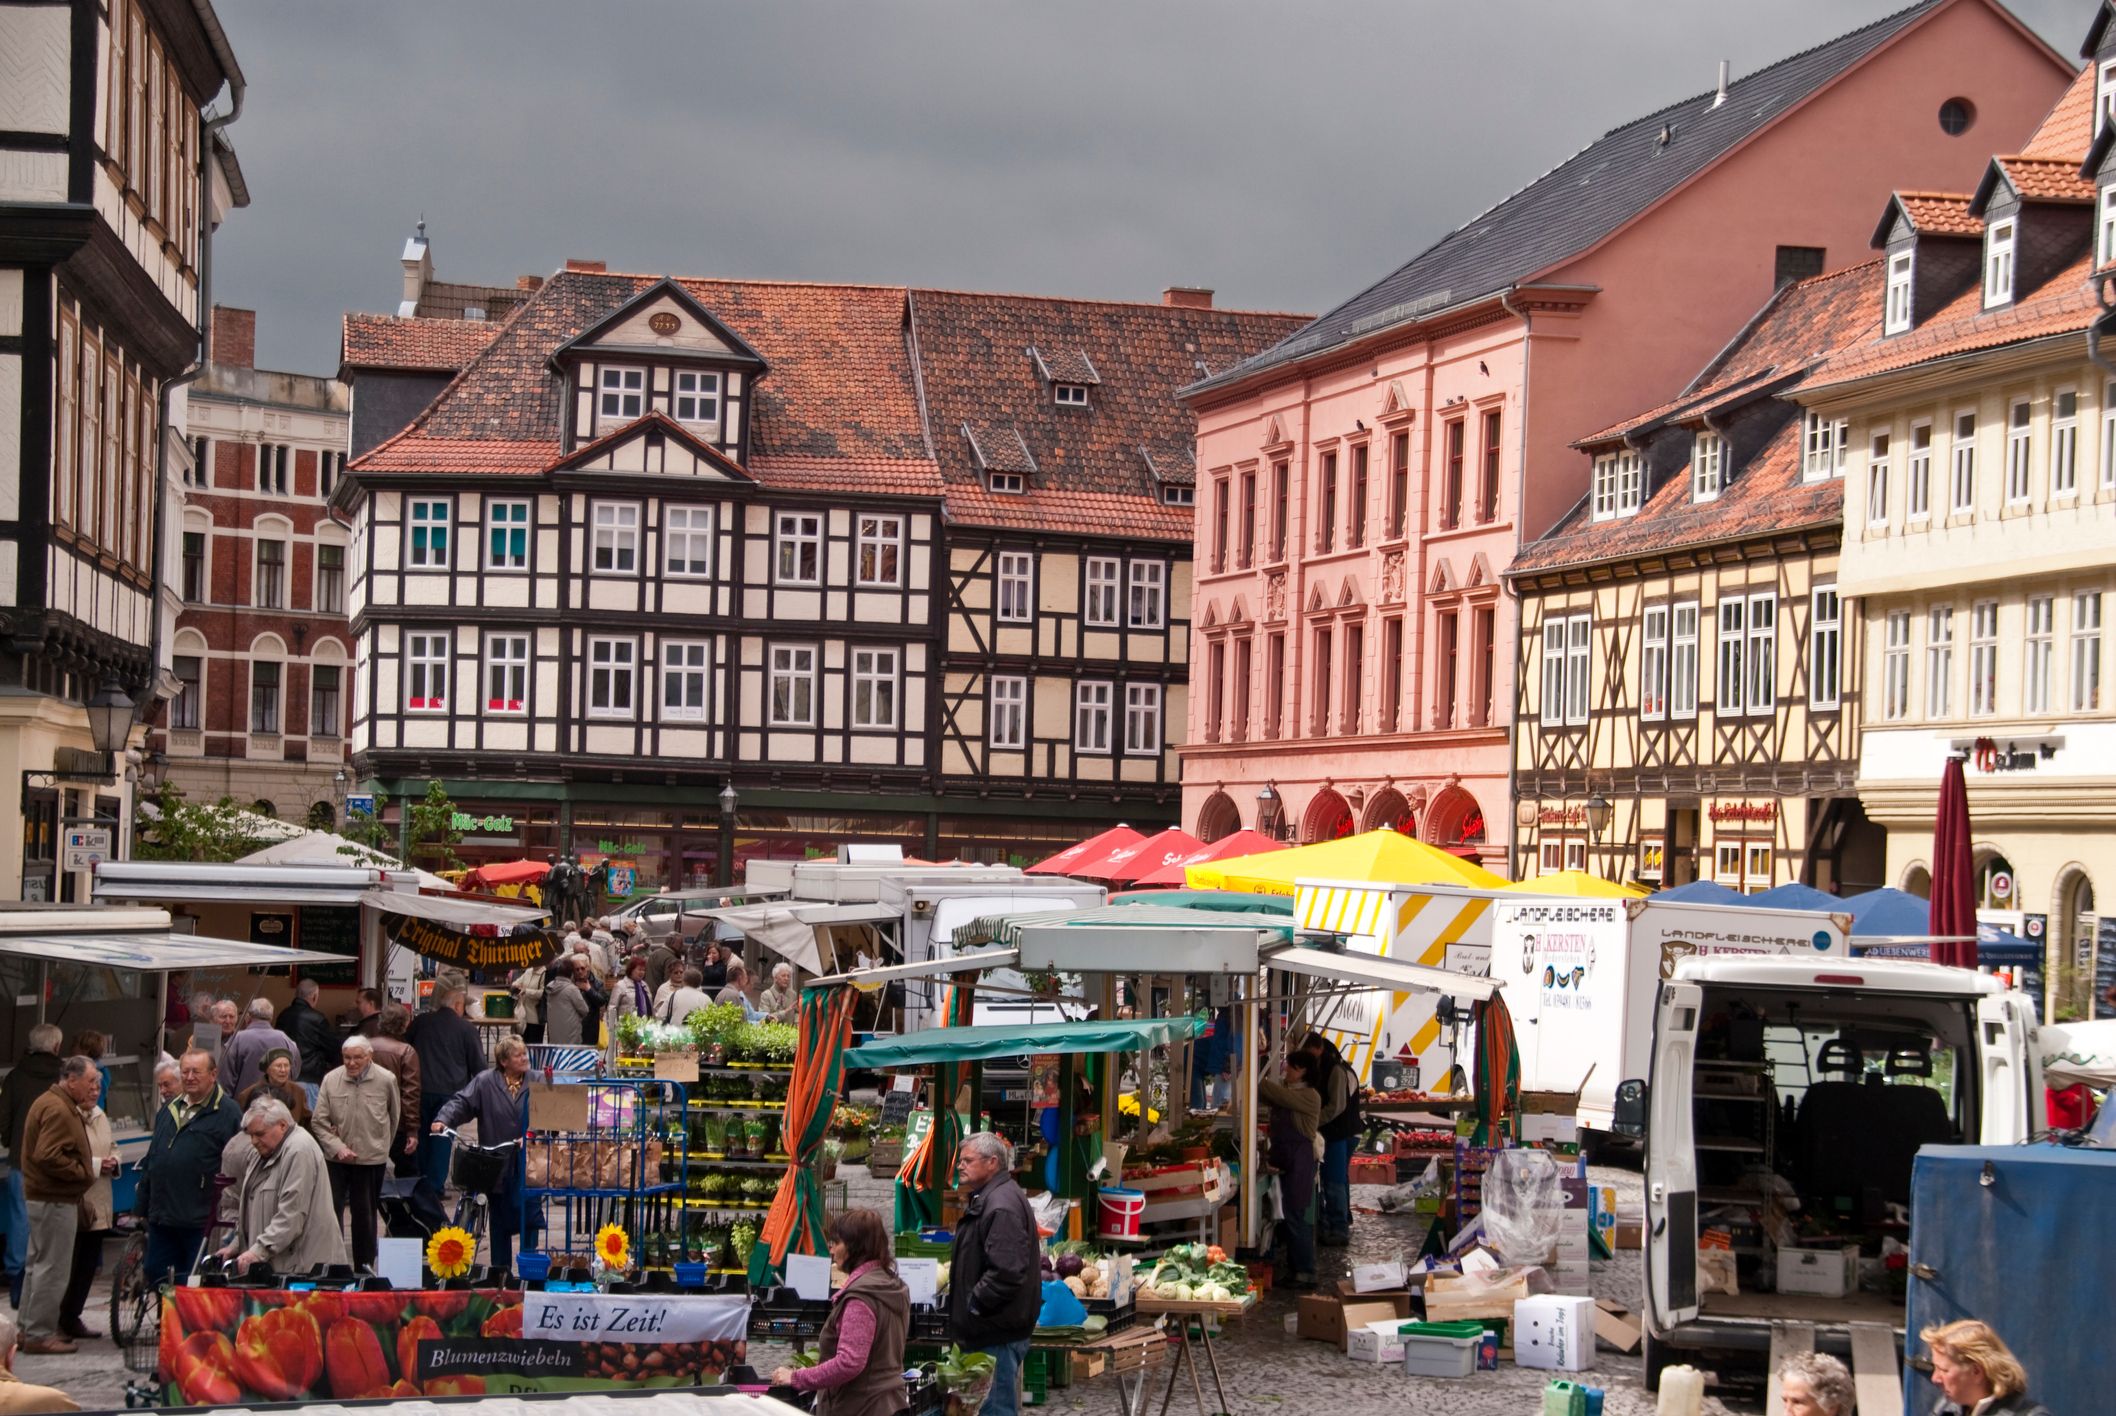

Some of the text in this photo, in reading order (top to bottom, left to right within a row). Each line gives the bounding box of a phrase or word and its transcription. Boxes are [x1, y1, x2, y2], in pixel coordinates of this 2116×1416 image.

[451, 812, 513, 832] Mäc-Geiz
[1513, 907, 1616, 923] LANDFLEISCHEREI
[402, 916, 543, 968] Original Thüringer
[1661, 928, 1811, 948] LANDFLEISCHEREI
[538, 1305, 666, 1332] Es ist Zeit!
[430, 1348, 572, 1369] Blumenzwiebeln
